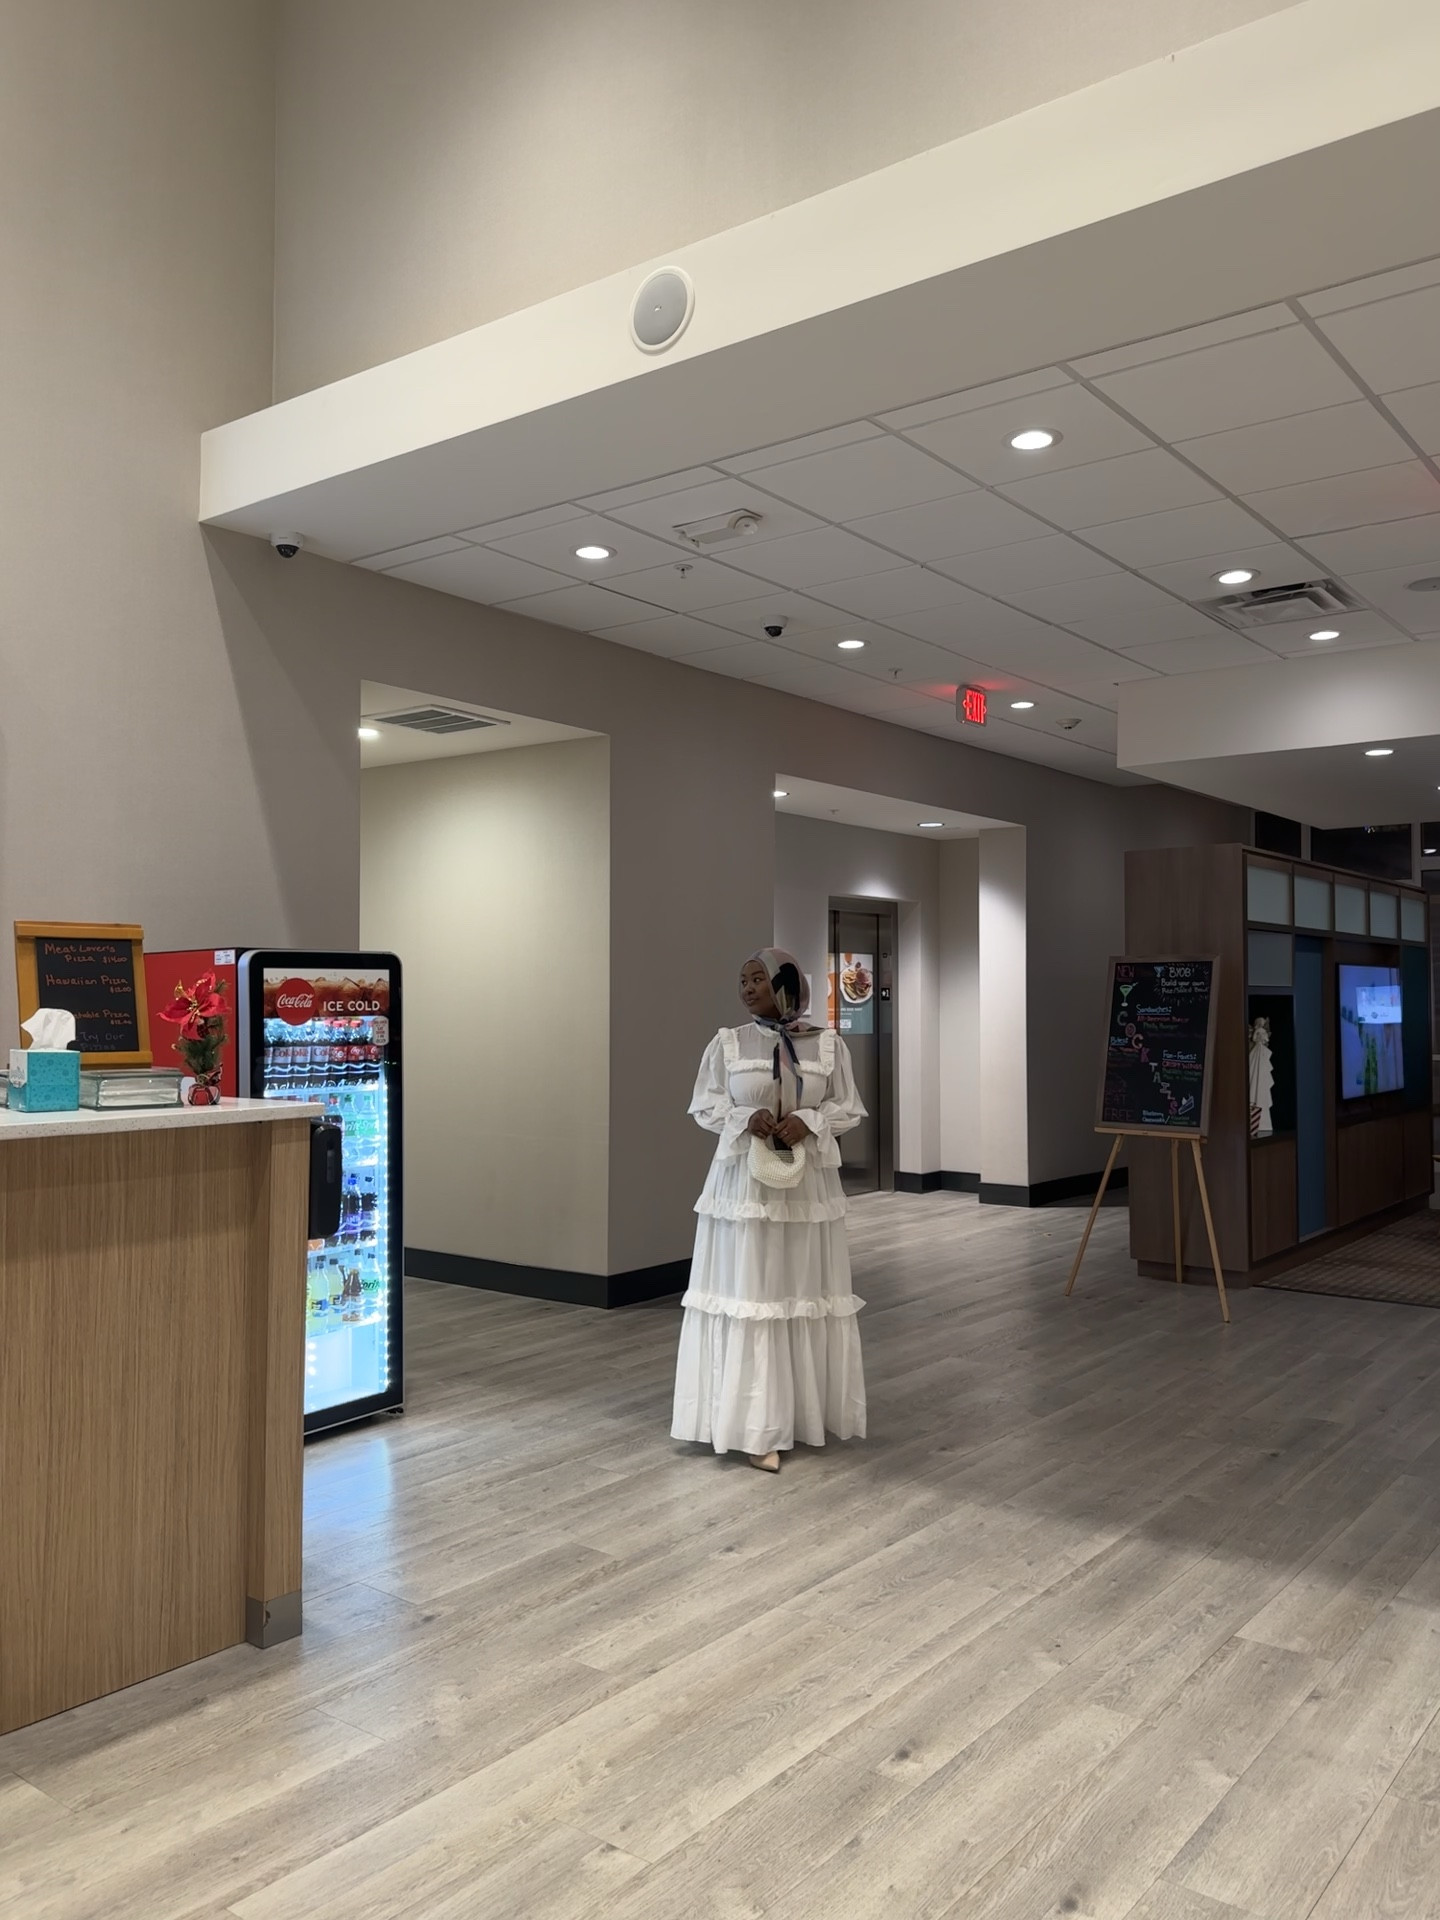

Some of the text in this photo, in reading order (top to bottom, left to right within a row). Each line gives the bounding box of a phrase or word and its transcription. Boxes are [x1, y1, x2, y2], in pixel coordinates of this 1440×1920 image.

[966, 689, 985, 724] EXIT
[44, 943, 76, 955] Meat
[64, 954, 95, 963] Pizza
[45, 974, 128, 986] Hawaiian Pizza
[323, 1000, 381, 1012] ICE COLD
[103, 1009, 130, 1018] Pizza
[79, 1032, 125, 1042] Try Our
